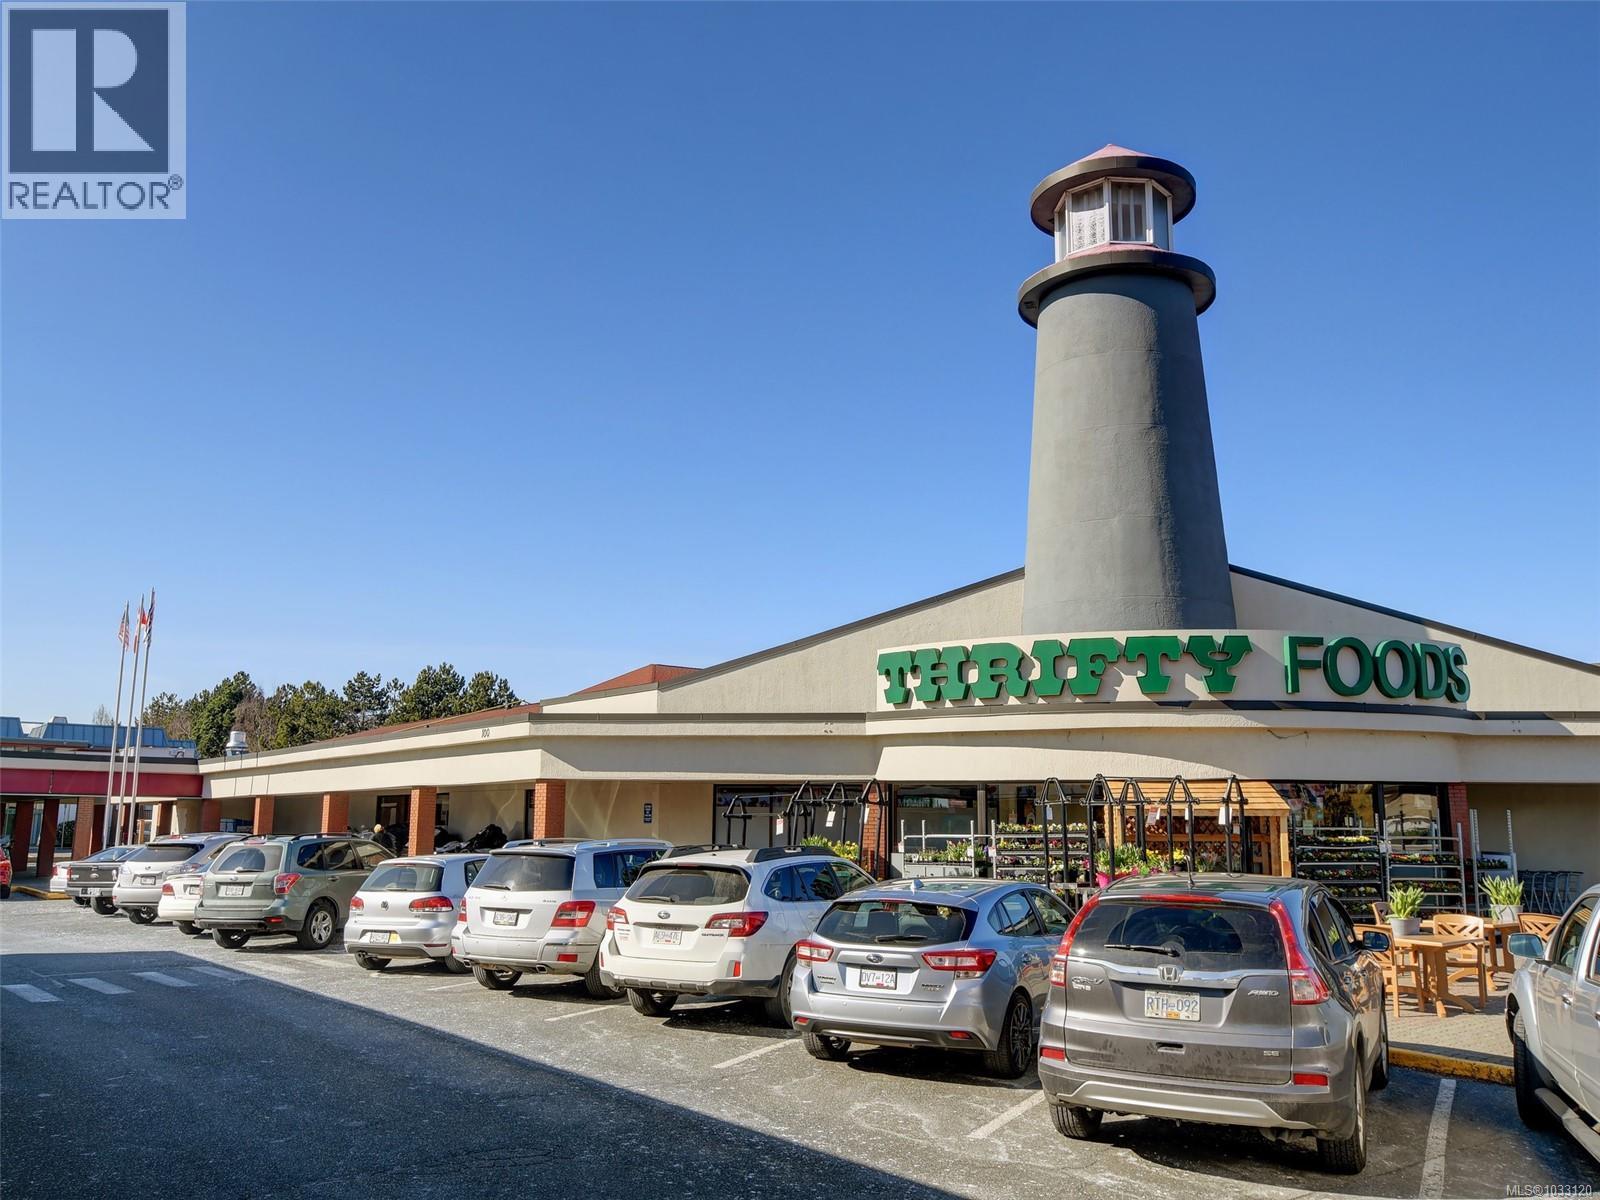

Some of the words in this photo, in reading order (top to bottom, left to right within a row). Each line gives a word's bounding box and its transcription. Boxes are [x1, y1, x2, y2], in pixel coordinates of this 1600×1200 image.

[877, 635, 1252, 705] THRIFTY
[1283, 636, 1471, 704] FOODS
[1146, 996, 1199, 1013] RTH-092
